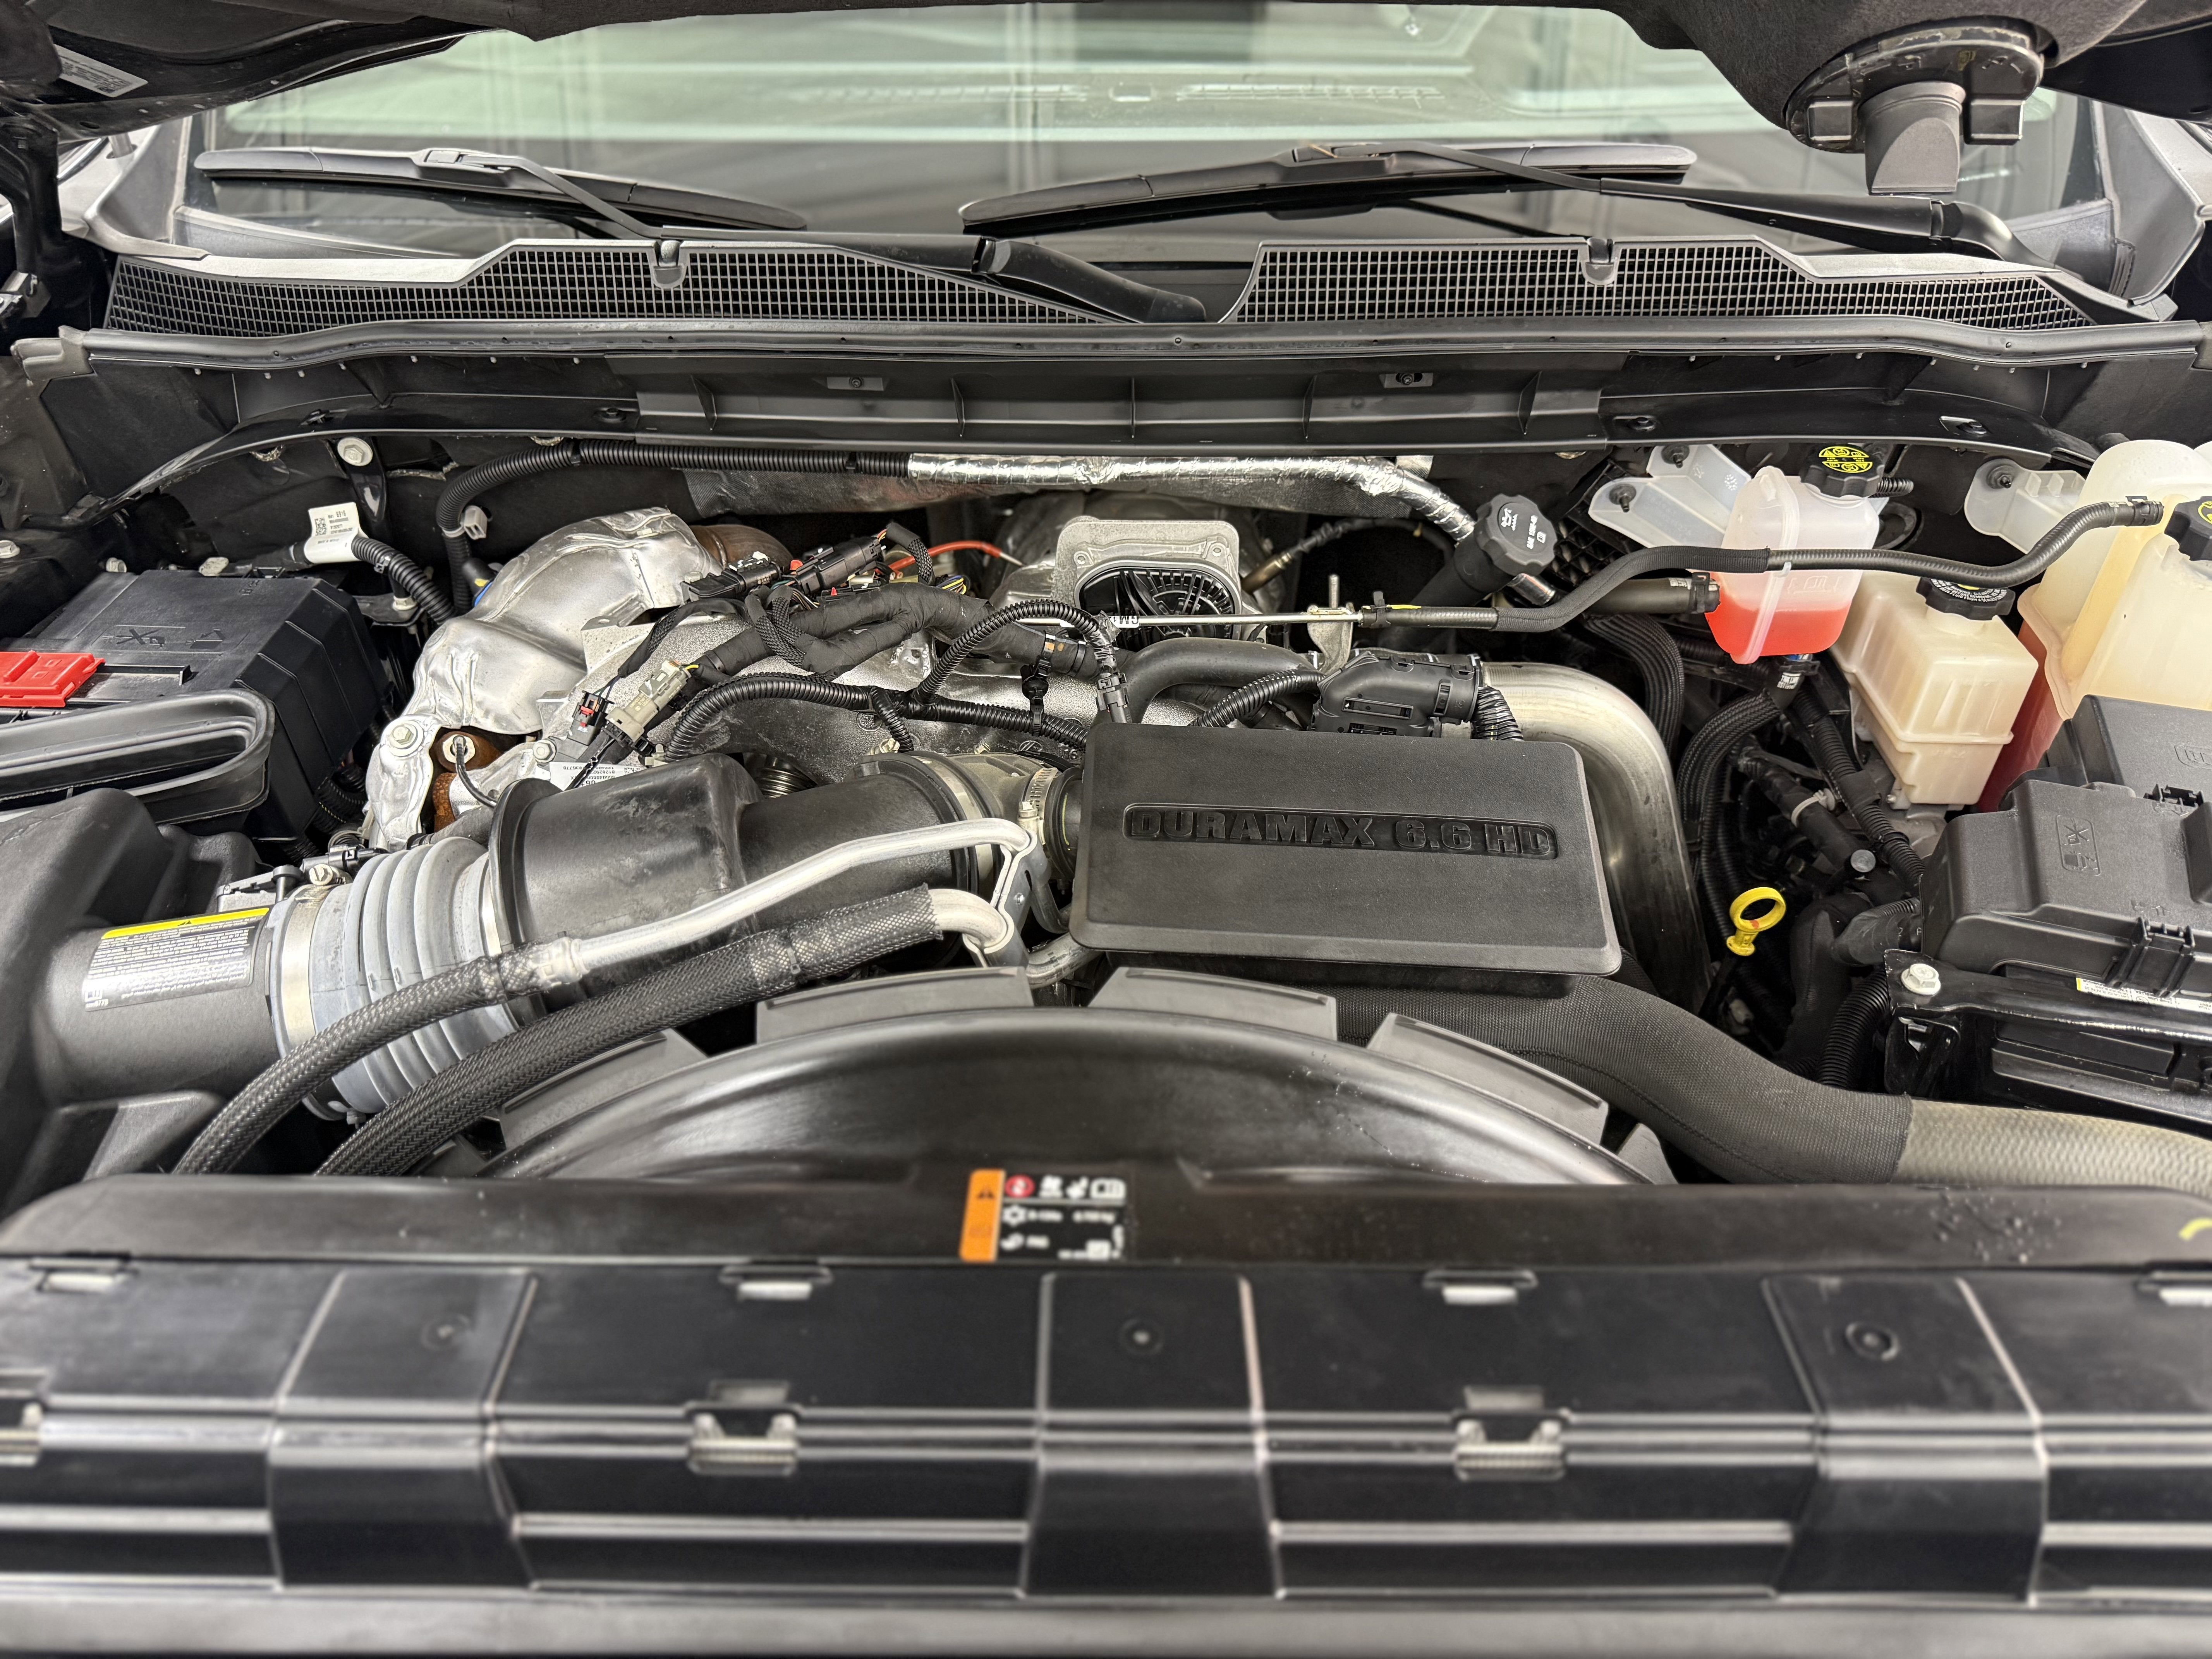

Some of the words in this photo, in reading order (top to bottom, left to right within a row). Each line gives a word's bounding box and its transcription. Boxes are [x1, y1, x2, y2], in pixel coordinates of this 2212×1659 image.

[1131, 811, 1374, 846] DURAMAX
[1395, 819, 1472, 850] 6.6
[1484, 824, 1549, 855] HD
